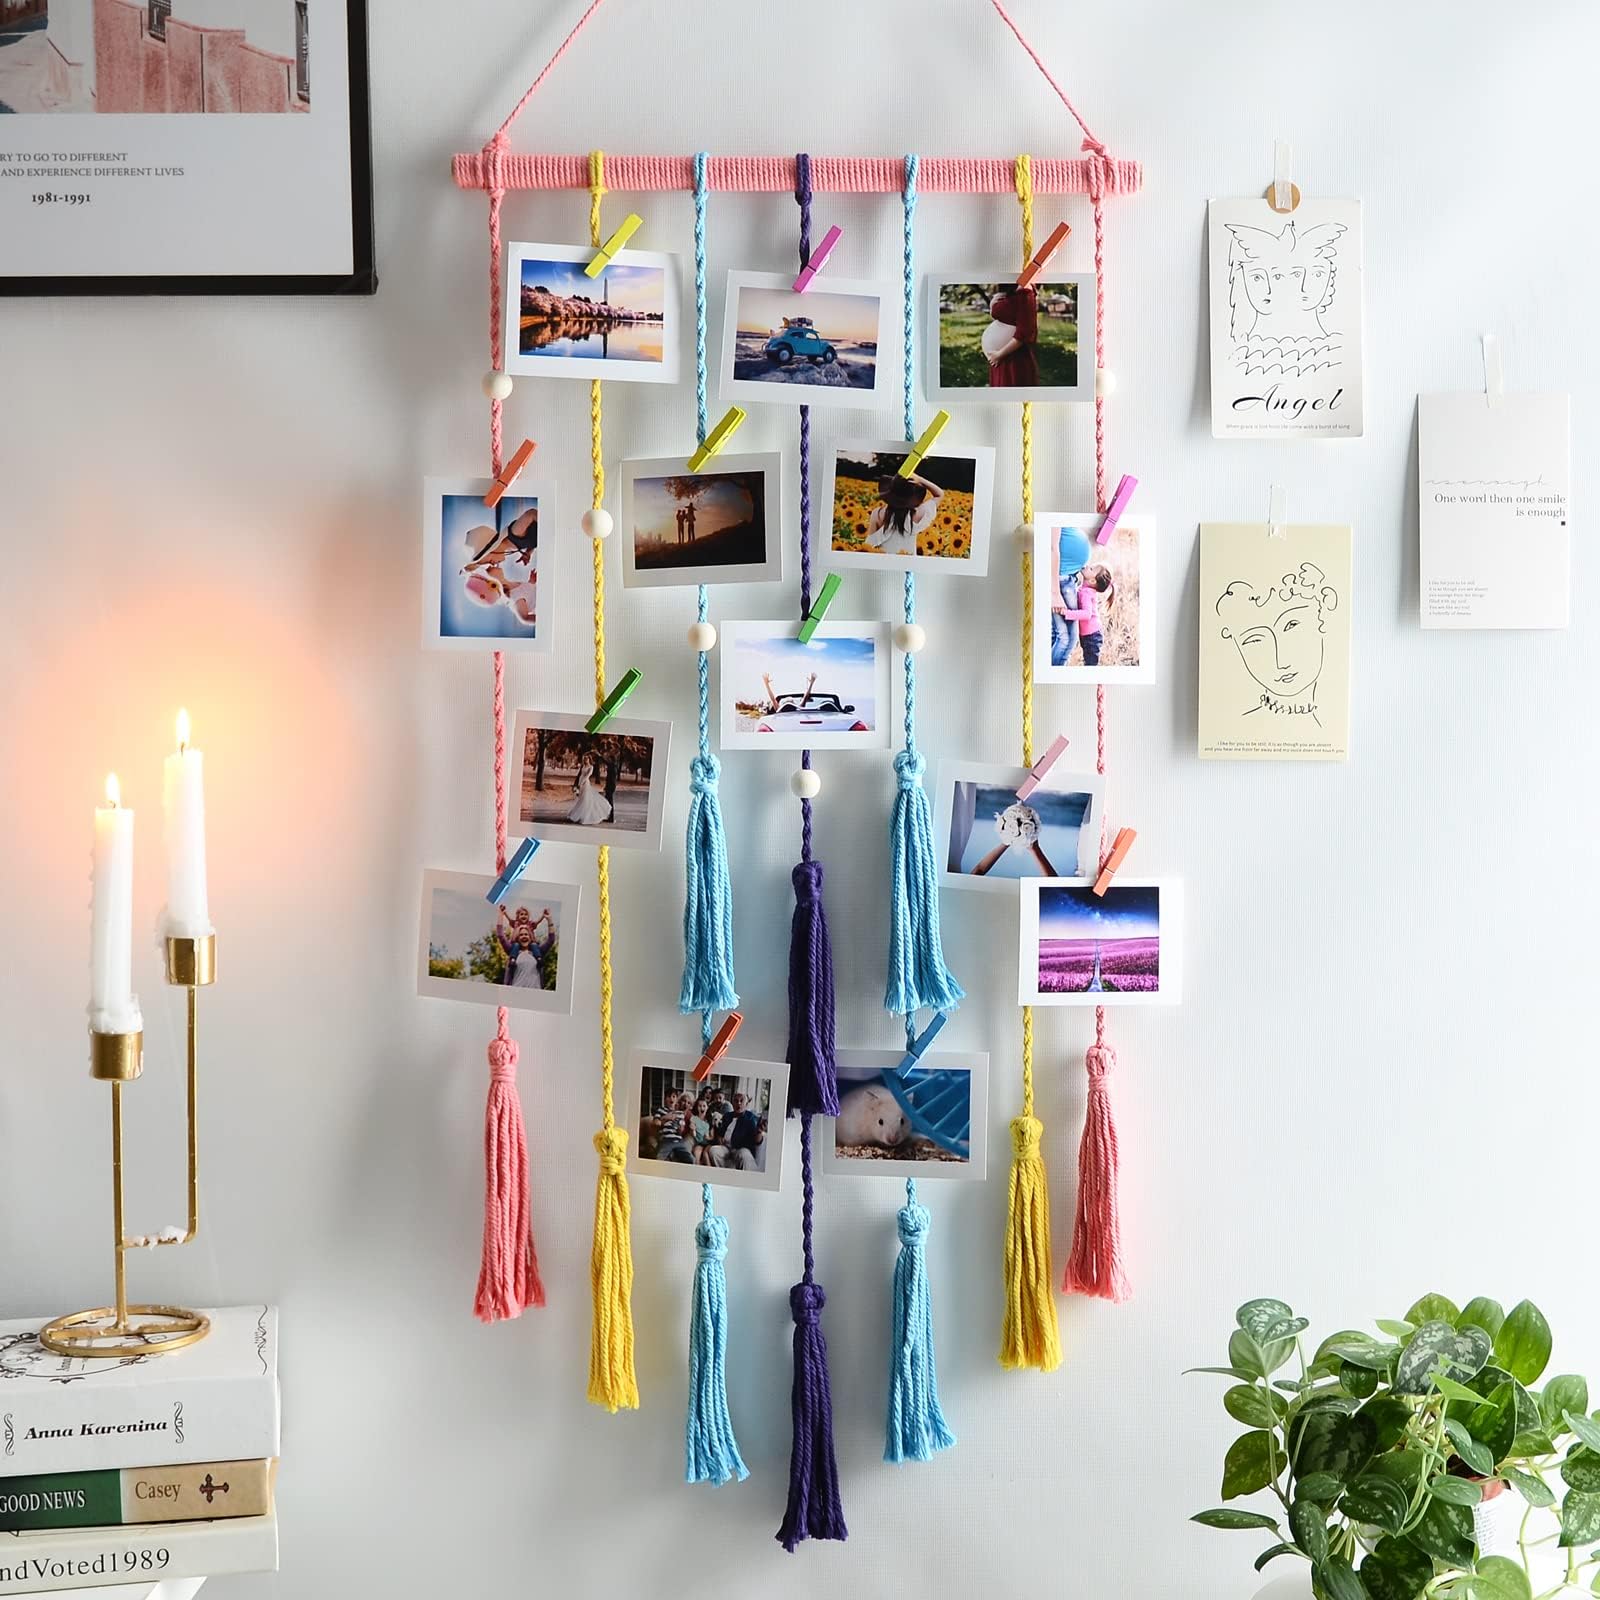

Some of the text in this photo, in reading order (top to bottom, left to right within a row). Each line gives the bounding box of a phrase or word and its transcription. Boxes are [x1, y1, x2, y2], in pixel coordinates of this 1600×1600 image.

[16, 153, 32, 162] TO
[33, 153, 50, 162] GO
[52, 153, 68, 162] TO
[69, 152, 128, 162] DIFFERENT
[0, 168, 185, 177] AND EXPERIENCE DIFFERENT LIVES
[32, 192, 91, 205] 1981-1991
[1232, 382, 1344, 420] Angel
[1434, 494, 1456, 503] One
[1460, 494, 1486, 503] word
[1490, 494, 1513, 504] then
[1538, 494, 1566, 504] smile
[1516, 508, 1566, 518] is enough
[24, 1420, 168, 1440] Anna Karenina
[135, 1481, 181, 1502] Casey
[0, 1490, 86, 1513] GOOD NEWS
